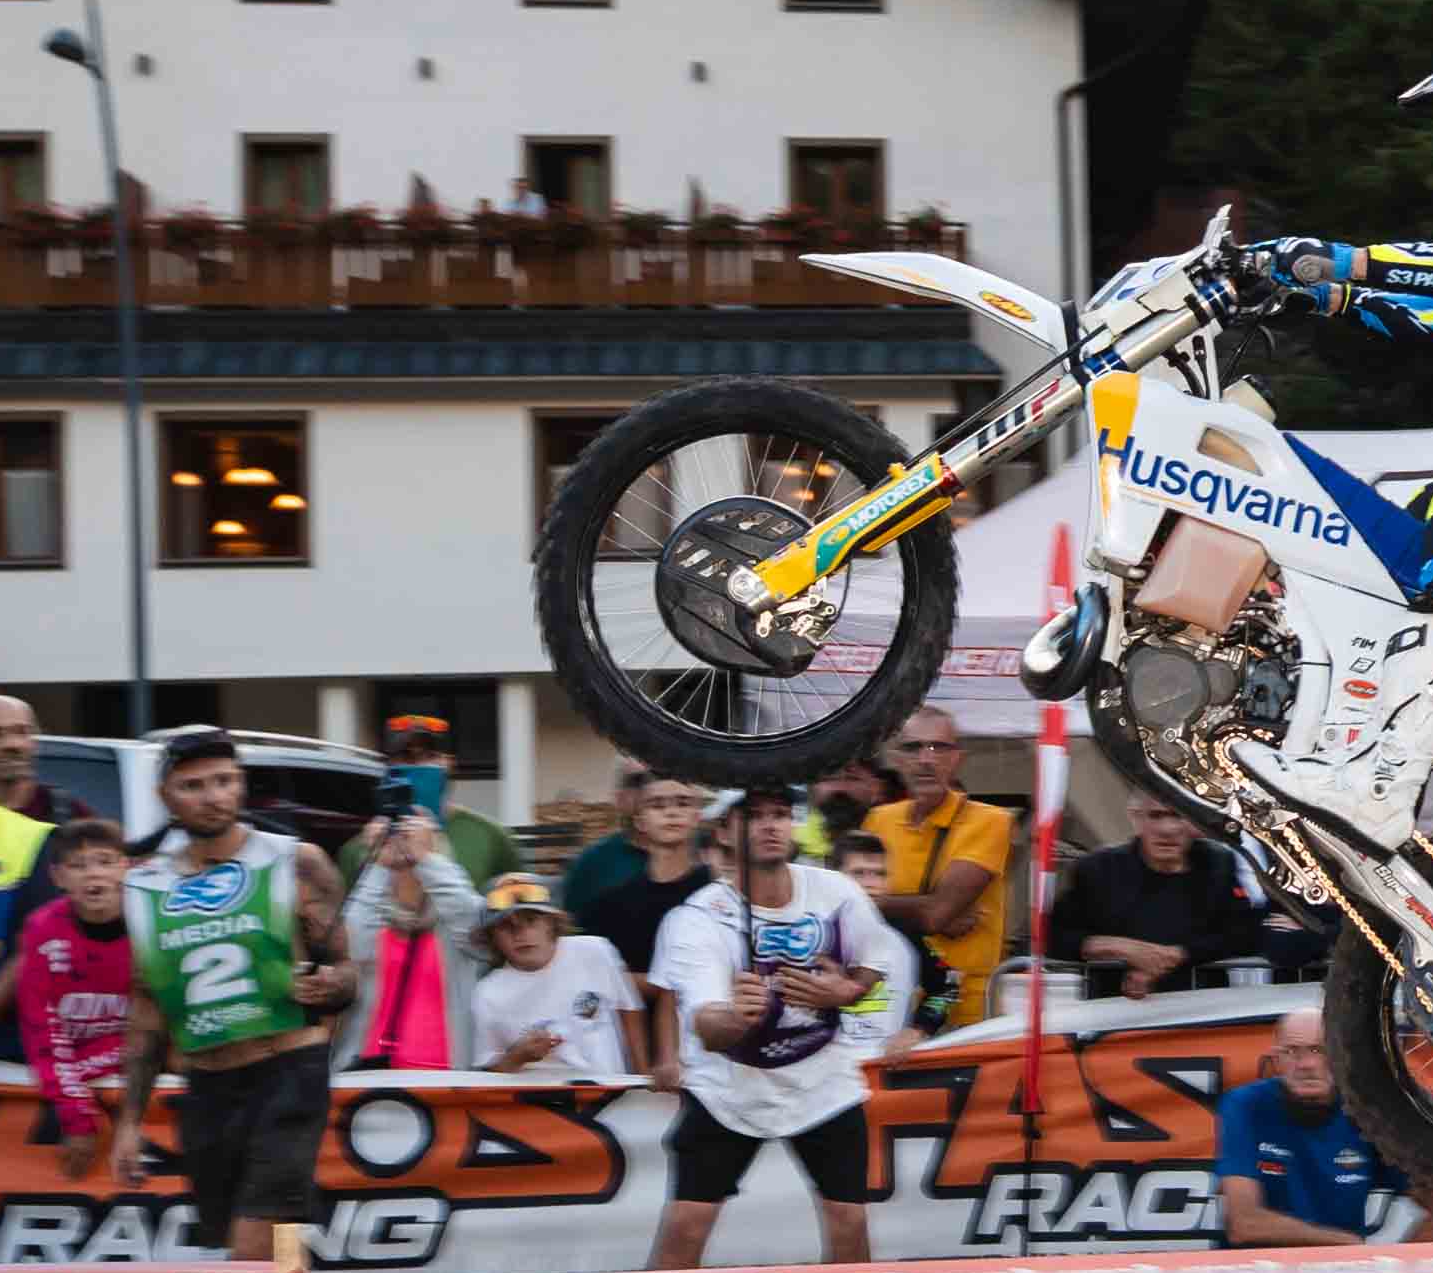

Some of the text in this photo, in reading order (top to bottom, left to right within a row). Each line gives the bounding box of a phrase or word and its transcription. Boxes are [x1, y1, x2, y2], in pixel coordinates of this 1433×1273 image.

[1386, 269, 1412, 285] S3
[848, 468, 932, 531] MOTOREX
[1097, 428, 1352, 547] Husqvarna
[160, 914, 264, 950] MEDIA
[180, 942, 259, 1006] 2
